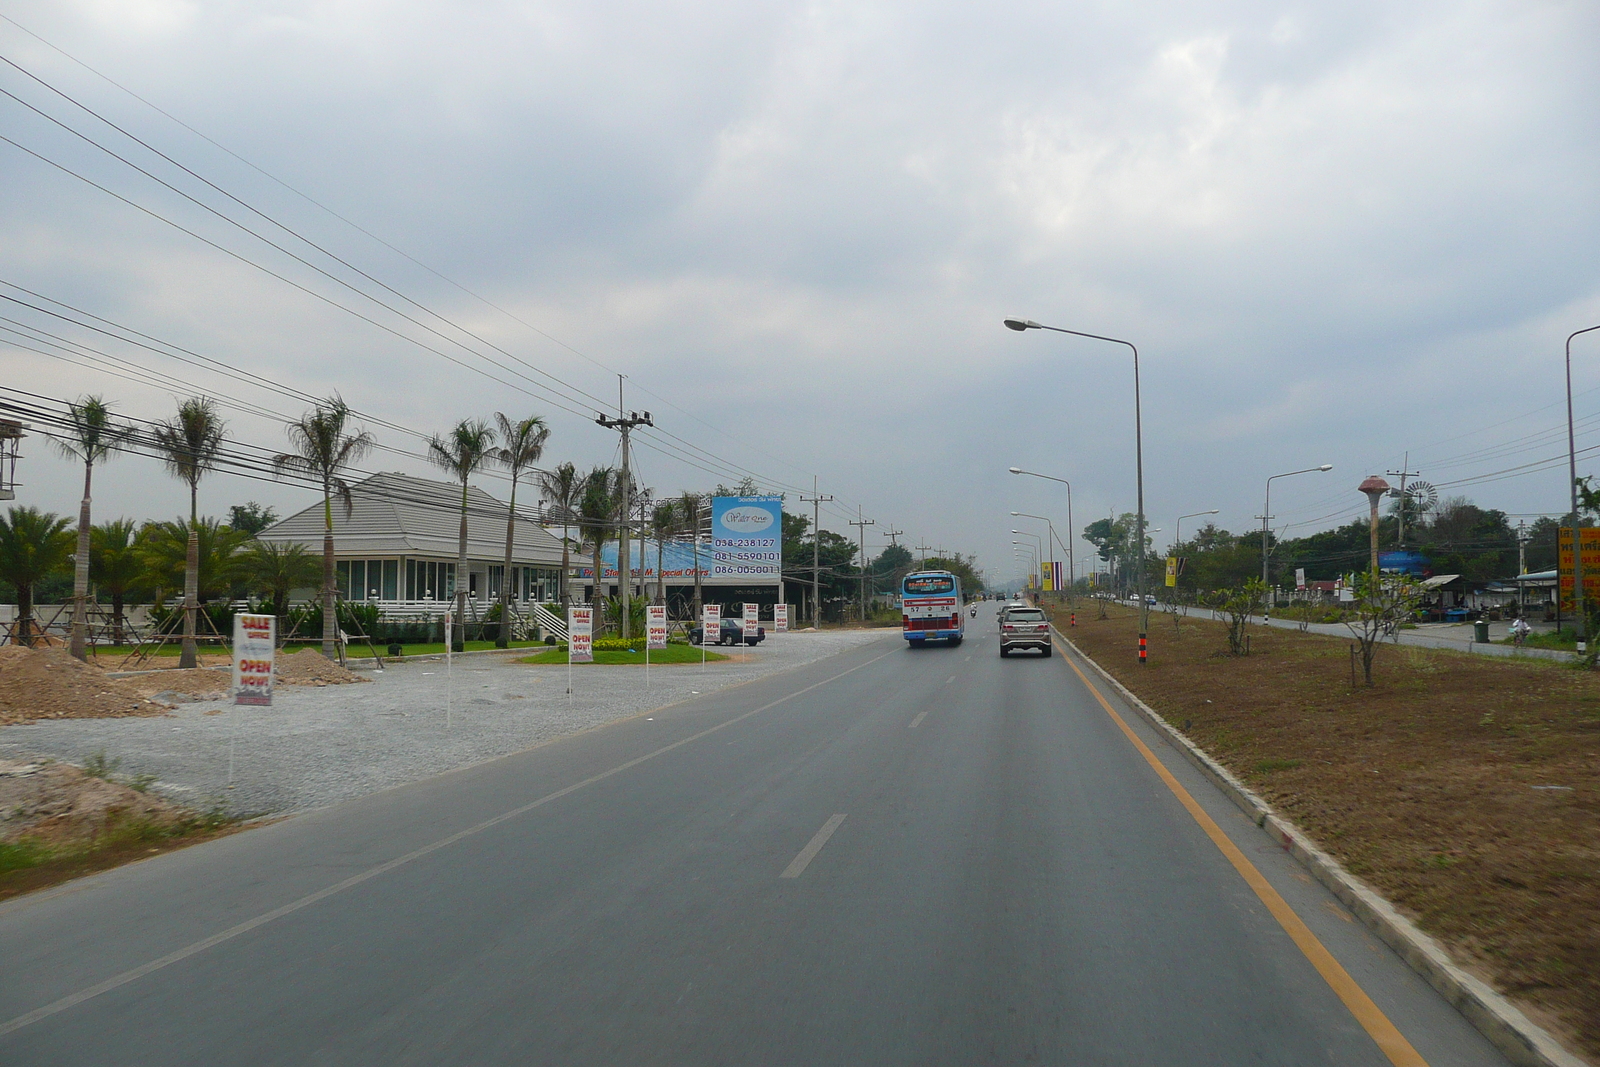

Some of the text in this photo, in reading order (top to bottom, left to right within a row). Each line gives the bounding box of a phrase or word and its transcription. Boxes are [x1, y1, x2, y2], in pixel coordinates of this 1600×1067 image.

[715, 539, 775, 547] 038-238127
[241, 616, 270, 629] SALE
[240, 660, 271, 672] OPEN
